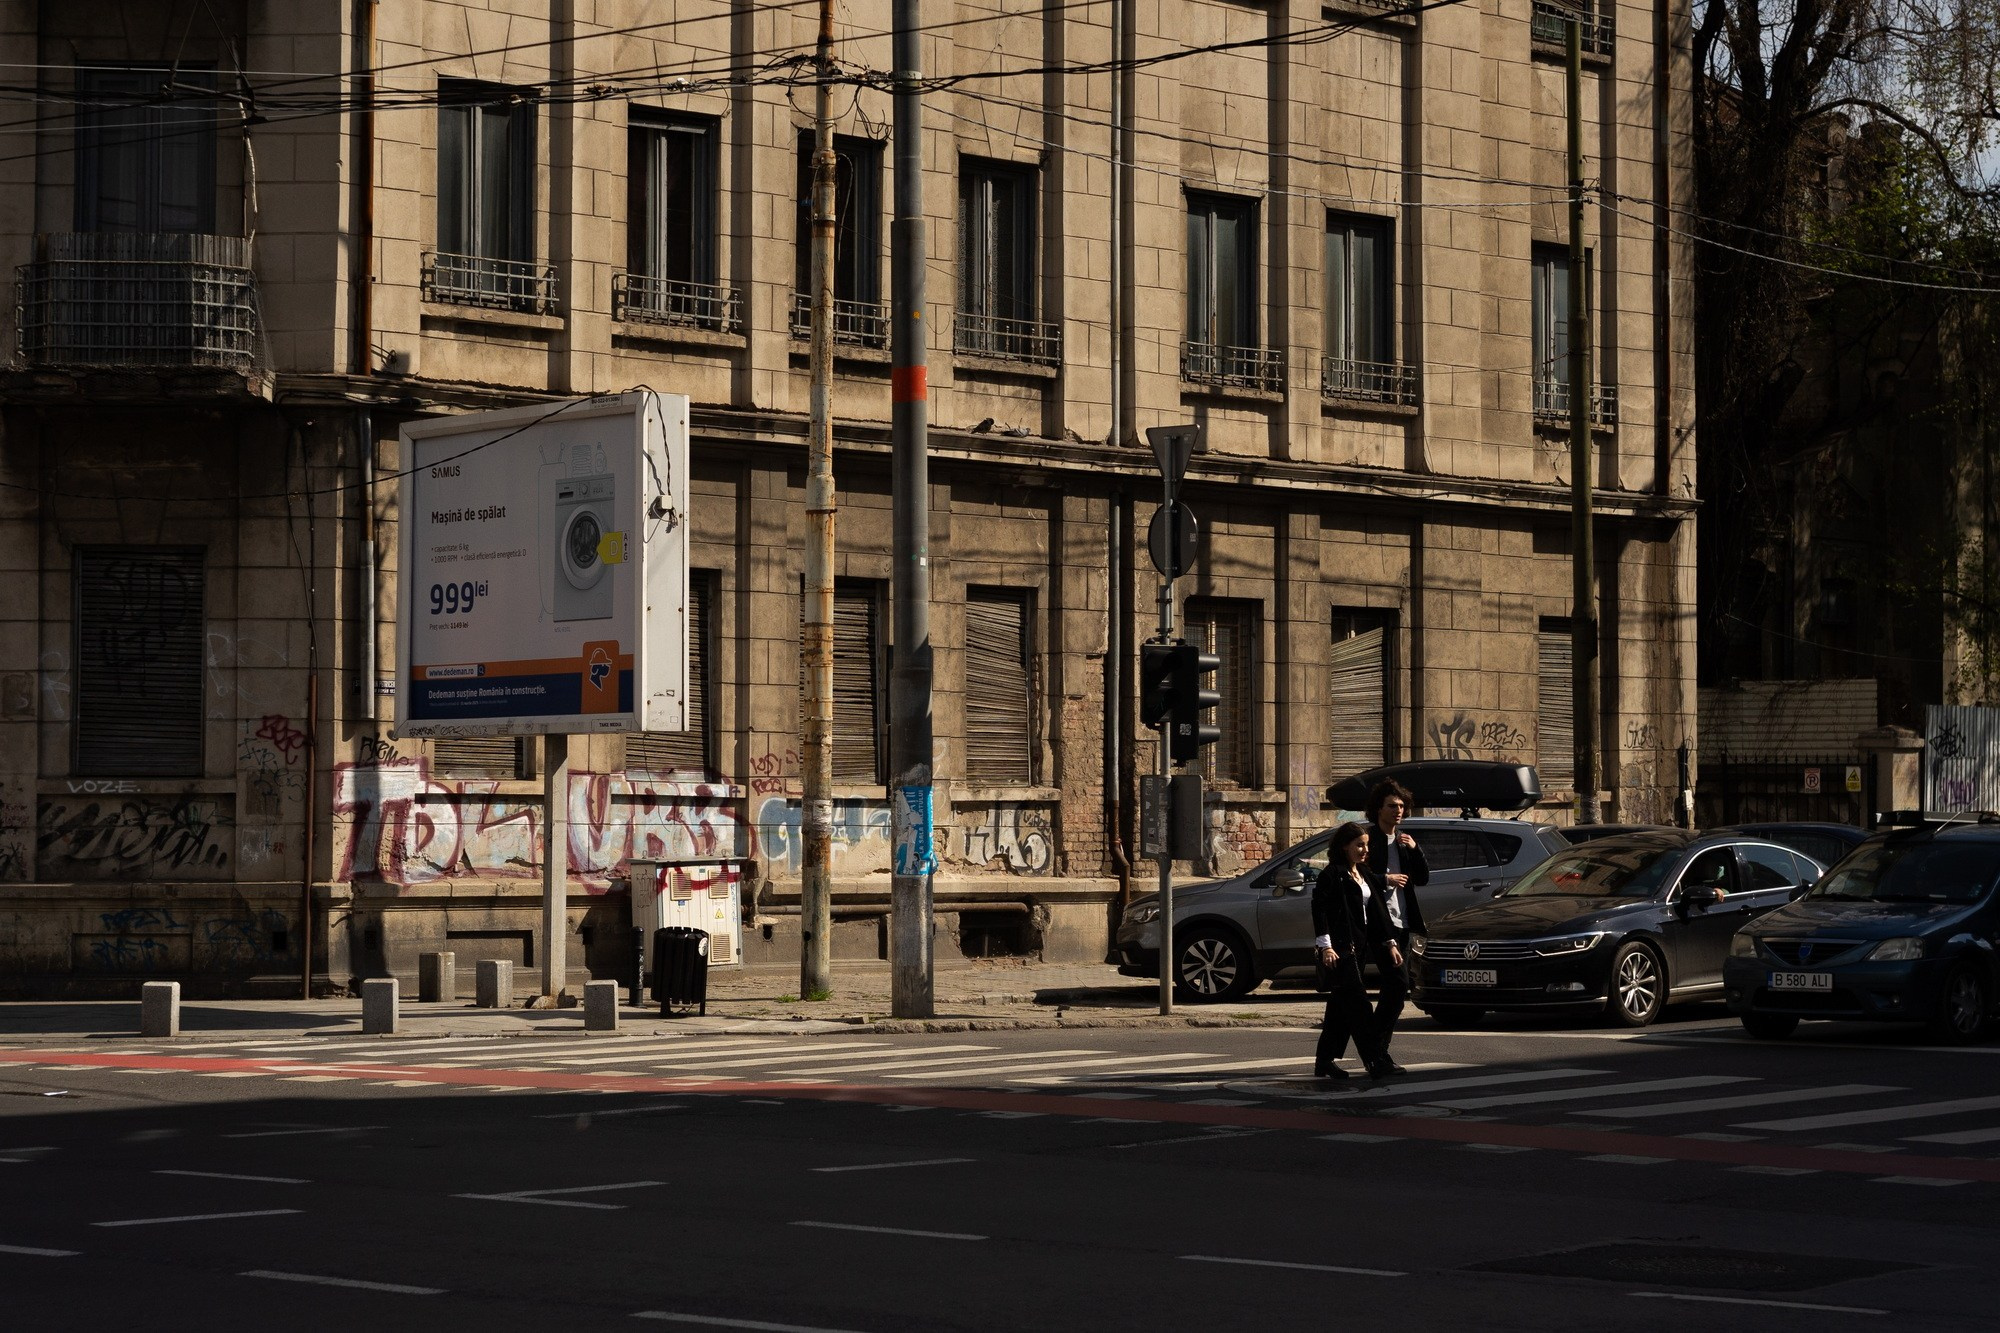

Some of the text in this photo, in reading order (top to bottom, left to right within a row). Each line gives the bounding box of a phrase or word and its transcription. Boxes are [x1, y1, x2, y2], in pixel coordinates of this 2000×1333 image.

[431, 465, 461, 478] SAMUS
[431, 505, 506, 526] Mașină de spălat
[458, 543, 463, 551] 6
[463, 543, 470, 552] kg
[609, 540, 619, 557] D
[434, 555, 447, 563] 1000
[447, 555, 458, 563] RPM
[430, 580, 489, 615] 999 lei
[428, 667, 475, 677] www.dedeman.ro
[428, 688, 456, 700] Dedeman
[456, 688, 478, 700] susține
[478, 686, 504, 698] România
[505, 686, 511, 697] în
[1447, 970, 1494, 983] B 606 GCL
[1775, 974, 1828, 987] B 580 ALI
